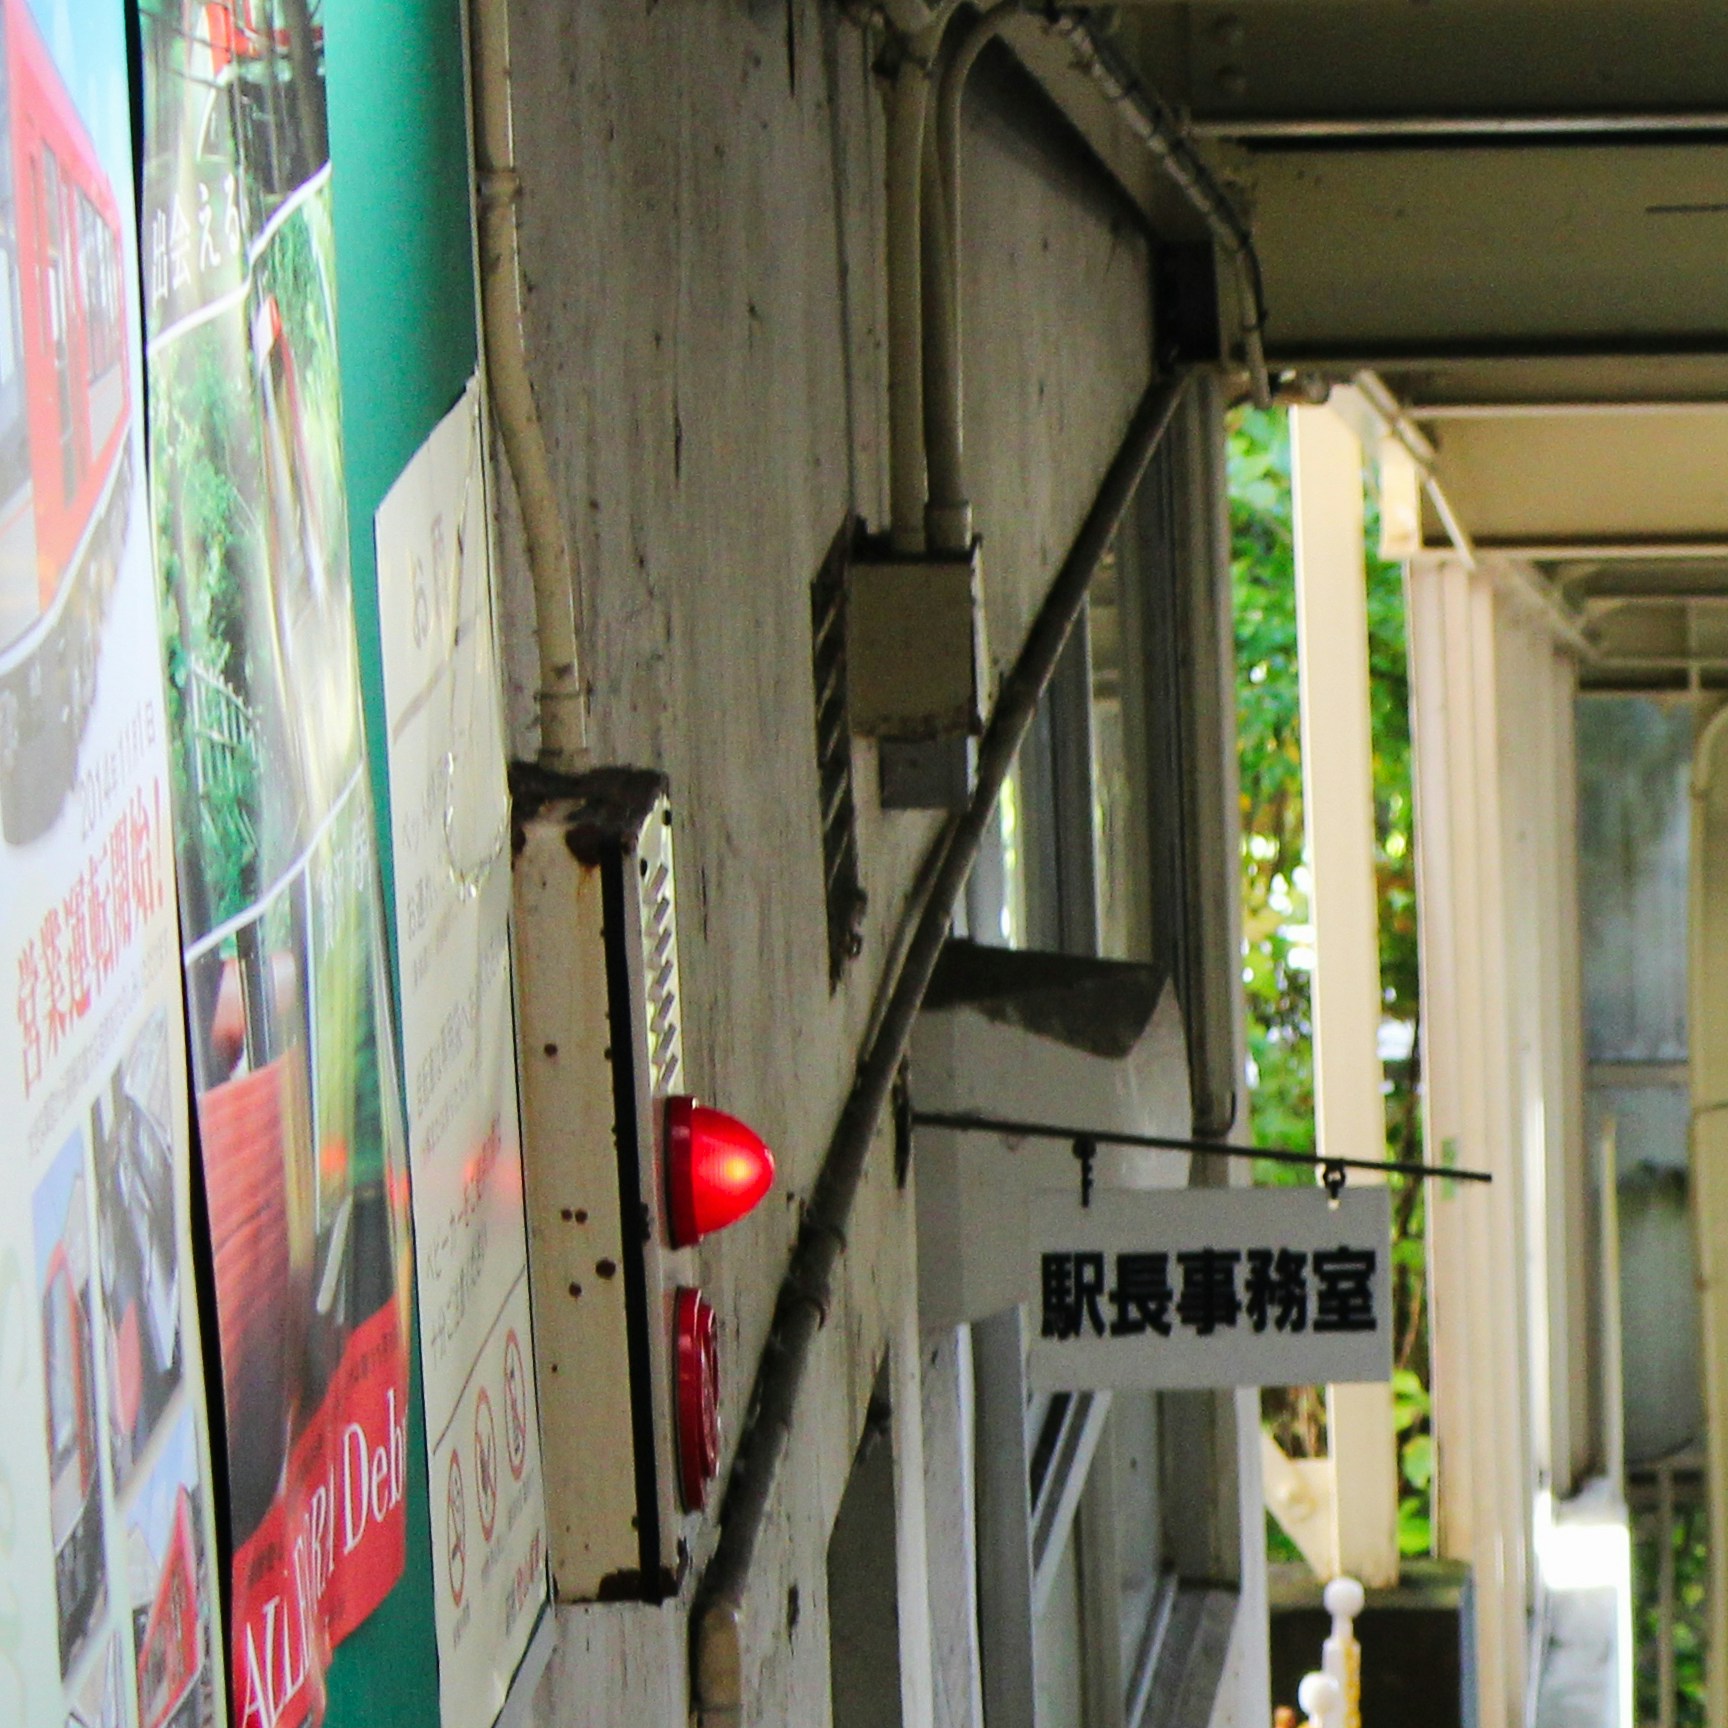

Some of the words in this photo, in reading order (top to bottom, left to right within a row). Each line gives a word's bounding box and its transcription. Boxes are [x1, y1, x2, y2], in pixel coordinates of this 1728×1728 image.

[151, 172, 242, 299] 出会える
[1041, 1246, 1378, 1340] 駅長事務室
[342, 1387, 408, 1557] Deb
